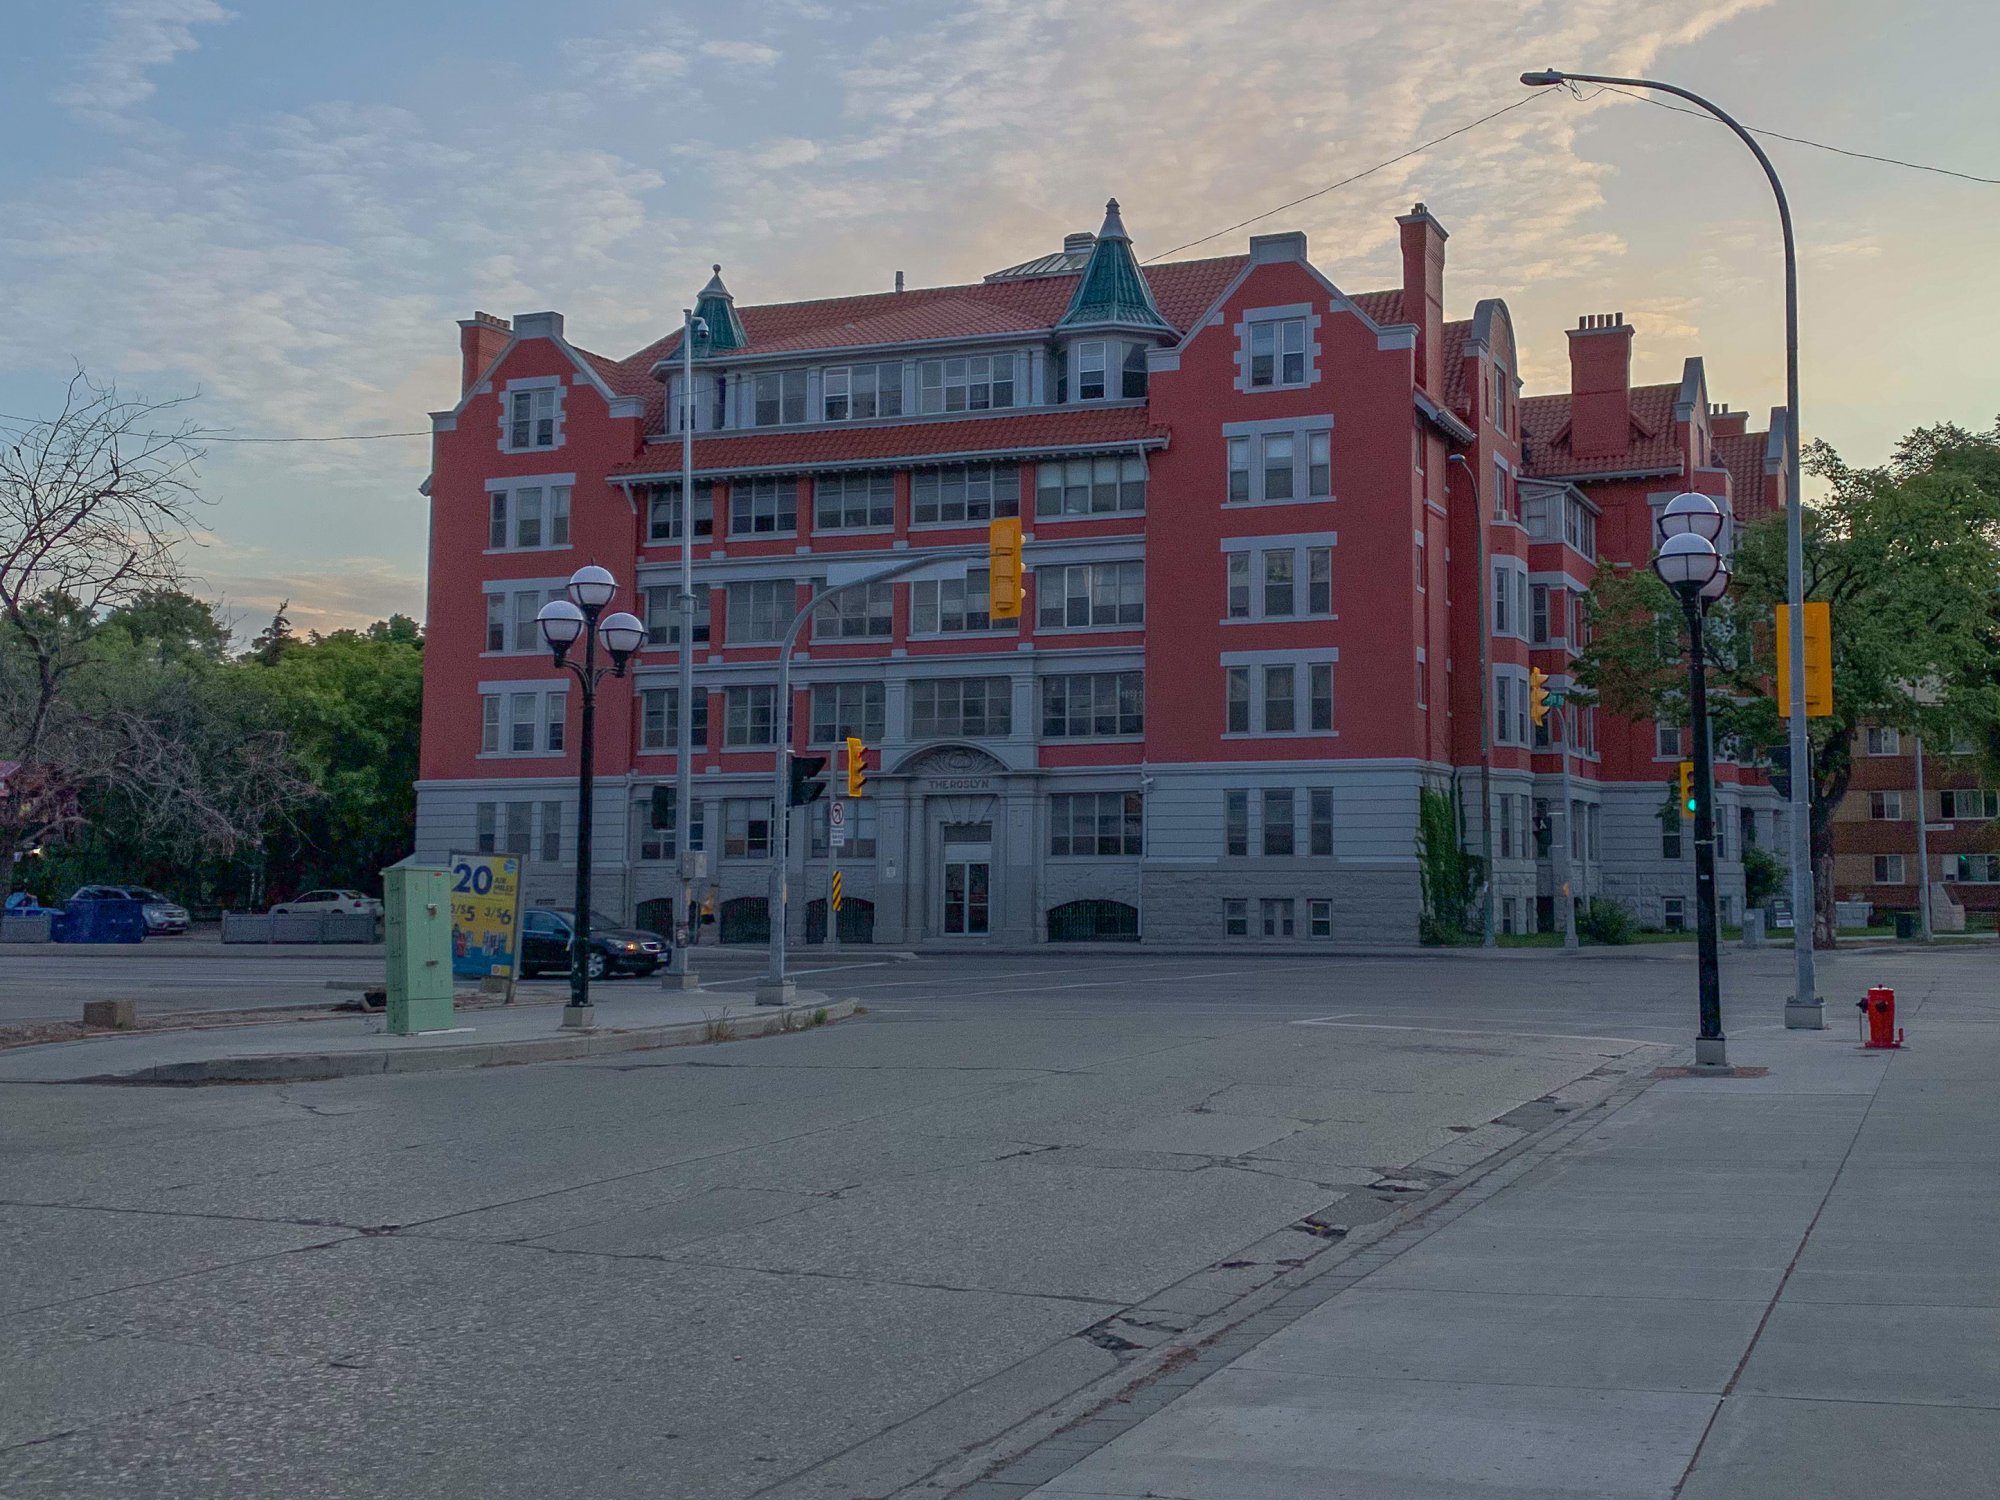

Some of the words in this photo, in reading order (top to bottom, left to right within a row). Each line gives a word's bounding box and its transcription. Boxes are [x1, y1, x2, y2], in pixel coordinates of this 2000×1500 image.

[928, 780, 949, 790] THE
[950, 778, 989, 789] ROSLYN
[452, 863, 493, 895] 20
